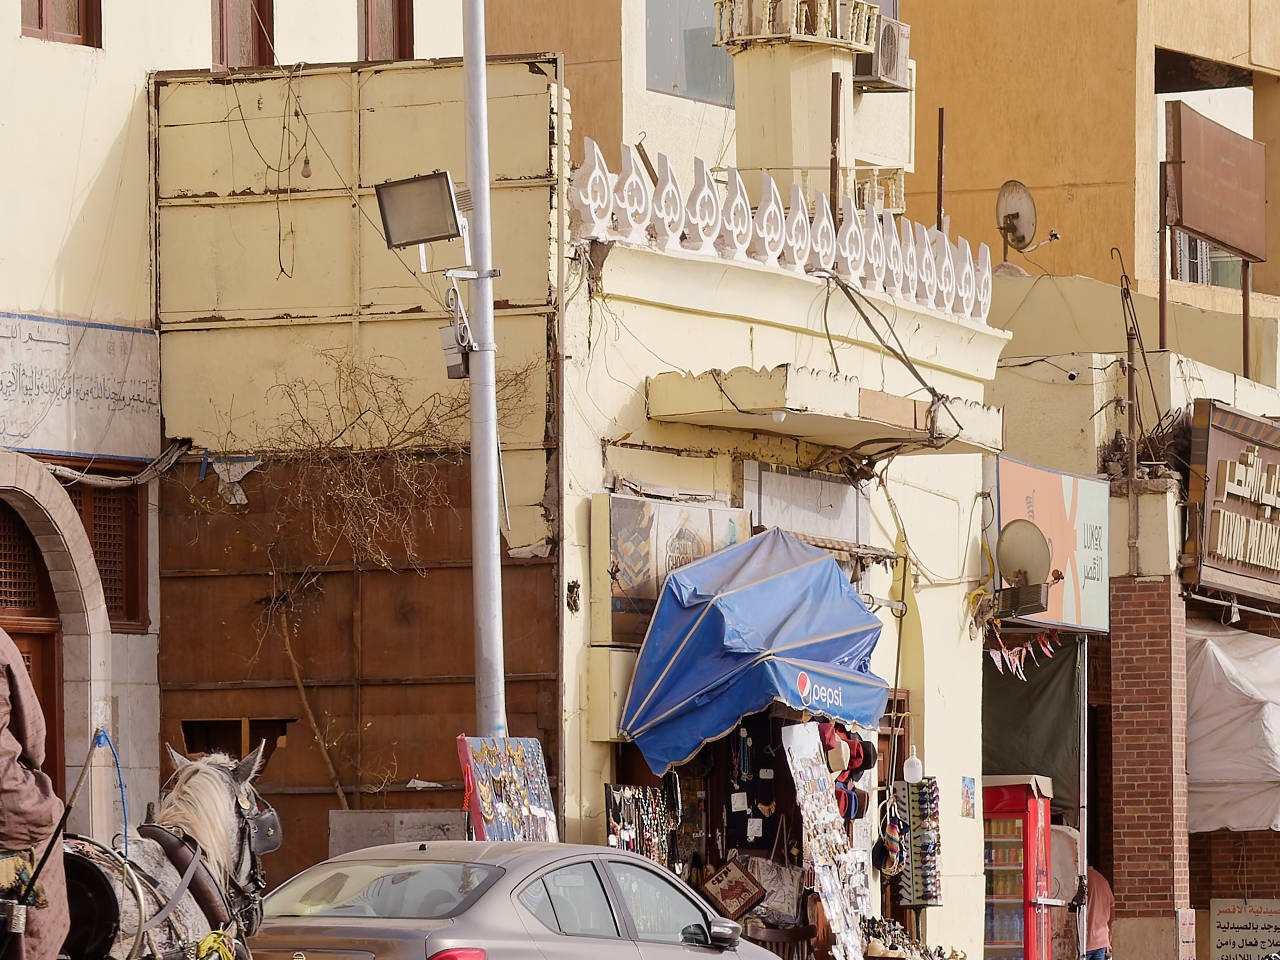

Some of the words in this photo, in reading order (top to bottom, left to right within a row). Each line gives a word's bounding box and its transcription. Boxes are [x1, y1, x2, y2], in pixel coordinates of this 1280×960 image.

[1216, 508, 1247, 561] LUXOR
[1245, 518, 1280, 571] PHARM
[812, 684, 843, 708] pepsi
